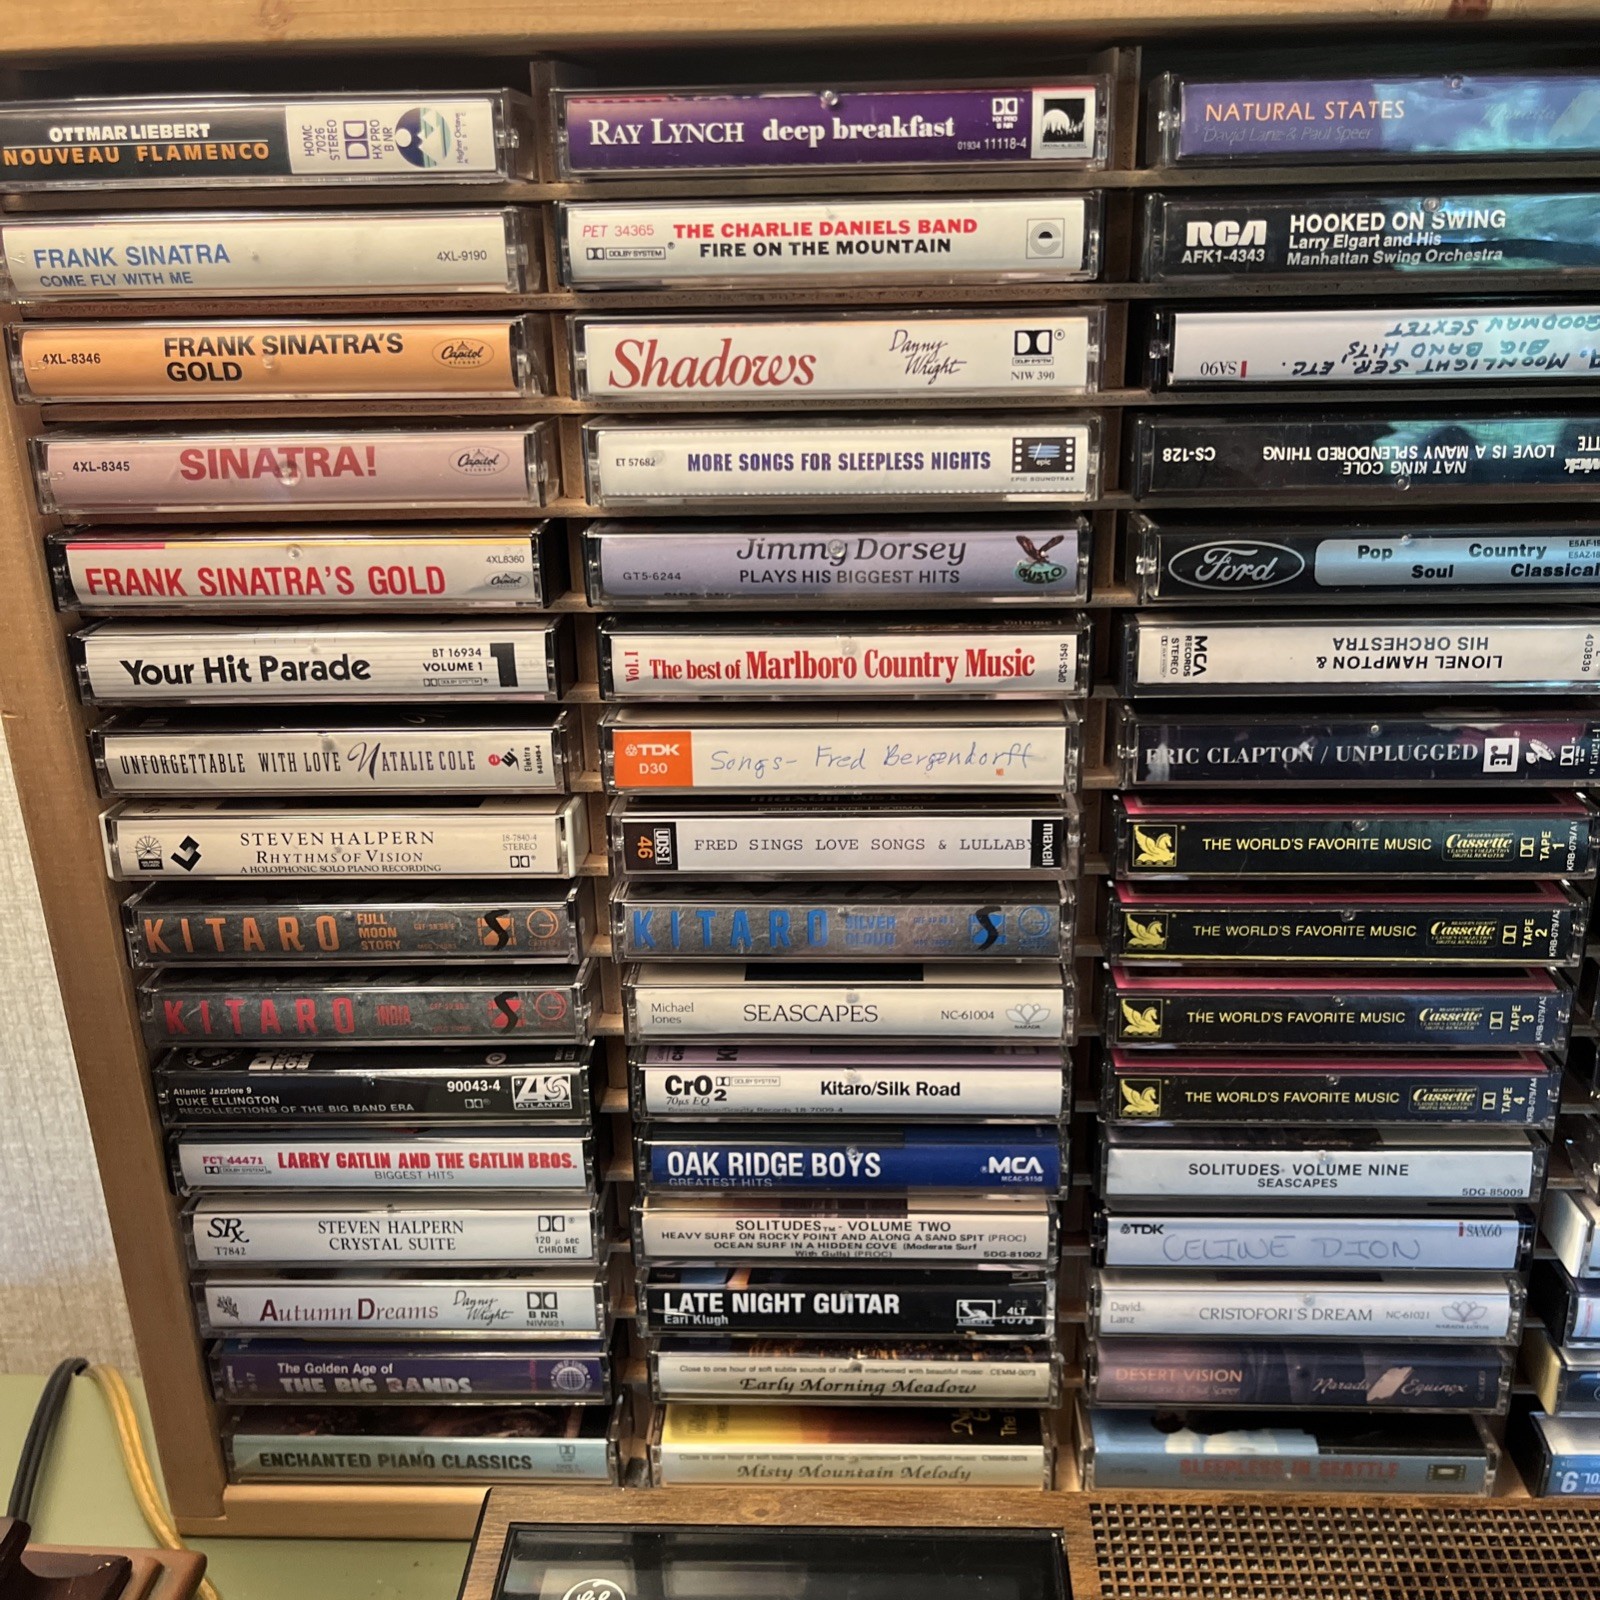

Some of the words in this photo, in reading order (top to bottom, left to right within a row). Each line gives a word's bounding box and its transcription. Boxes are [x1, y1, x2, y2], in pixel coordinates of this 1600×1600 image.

[1205, 102, 1315, 121] NATURAL
[1325, 101, 1405, 120] STATES
[49, 125, 127, 142] OTTMAR
[129, 124, 210, 140] LIEBERT
[369, 120, 381, 142] PRO
[302, 125, 315, 156] HOMC
[316, 127, 327, 153] 7026
[327, 120, 340, 160] STEREO
[3, 144, 120, 166] NOUVEAU
[138, 142, 269, 162] FLAMENCO
[373, 143, 383, 160] HX
[673, 225, 715, 239] THE
[720, 223, 814, 238] CHARLIE
[819, 221, 911, 236] DANIELS
[918, 219, 978, 234] BAND
[1290, 214, 1385, 233] HOOKED
[1392, 212, 1424, 231] ON
[1431, 210, 1506, 230] SWING
[583, 225, 608, 238] PET
[613, 224, 655, 237] 34365
[1186, 220, 1267, 247] RCA
[33, 249, 117, 269] FRANK
[126, 244, 231, 266] SINATRA
[436, 250, 488, 261] 4XL-9190
[1181, 250, 1265, 263] AFK1-4343
[39, 274, 88, 288] COME
[90, 273, 117, 286] FLY
[122, 272, 164, 285] WITH
[168, 271, 193, 284] ME
[1383, 319, 1477, 337] SEXTET
[163, 336, 255, 357] FRANK
[261, 333, 403, 356] SINATRA'S
[42, 353, 101, 365] 4XL-8346
[609, 338, 816, 389] Shadows
[166, 361, 242, 383] GOLD
[1010, 372, 1032, 380] NIW
[1036, 371, 1055, 380] 390
[1200, 362, 1236, 376] SA90
[687, 454, 733, 473] MORE
[739, 454, 794, 472] SONGS
[801, 454, 831, 471] FOR
[839, 452, 924, 471] SLEEPLESS
[930, 451, 991, 471] NIGHTS
[1163, 447, 1216, 462] CS-128
[72, 461, 130, 472] 4XL-8345
[179, 446, 376, 481] SINATRA!
[1343, 461, 1383, 475] COLE
[1390, 461, 1428, 475] KING
[1433, 461, 1467, 474] NAT
[486, 555, 525, 563] 4XL8360
[737, 538, 848, 566] Jimmy
[853, 538, 966, 564] Dorsey
[1358, 545, 1393, 560] Pop
[1469, 543, 1547, 560] Country
[1195, 548, 1276, 582] Ford
[85, 568, 183, 597] FRANK
[199, 567, 355, 597] SINATRA'S
[368, 566, 446, 595] GOLD
[740, 570, 797, 583] PLAYS
[802, 569, 832, 583] HIS
[836, 569, 914, 583] BIGGEST
[918, 570, 960, 582] HITS
[431, 648, 446, 658] BT
[448, 647, 482, 658] 16934
[1170, 638, 1179, 675] STEREO
[1193, 635, 1207, 676] MCA
[120, 659, 195, 685] Your
[203, 655, 252, 683] Hit
[260, 654, 371, 681] Parade
[422, 661, 474, 672] VOLUME
[477, 661, 483, 671] 1
[649, 658, 683, 680] The
[687, 659, 722, 679] best
[725, 659, 741, 679] of
[746, 650, 857, 680] Marlboro
[864, 649, 960, 683] Country
[965, 648, 1035, 678] Music
[1317, 656, 1326, 668] &
[1332, 656, 1430, 669] HAMPTON
[1436, 655, 1502, 668] LIONEL
[637, 744, 680, 756] TDK
[121, 754, 247, 775] UNFORGETTABLE
[258, 752, 299, 773] WITH
[304, 751, 341, 772] LOVE
[524, 747, 532, 772] Elektra
[639, 763, 668, 775] D30
[240, 832, 329, 847] STEVEN
[331, 831, 435, 845] HALPERN
[1042, 823, 1054, 866] maxell
[1202, 839, 1231, 851] THE
[1236, 838, 1303, 851] WORLD'S
[1308, 838, 1379, 850] FAVORITE
[1384, 838, 1432, 850] MUSIC
[1540, 830, 1552, 861] TAPE
[638, 836, 654, 859] 46
[356, 914, 388, 926] FULL
[144, 915, 343, 954] KITARO
[359, 927, 397, 939] MOON
[632, 909, 829, 949] KITARO
[1522, 918, 1534, 947] TAPE
[1535, 928, 1548, 937] 2
[361, 941, 401, 951] STORY
[651, 1002, 694, 1013] Michael
[743, 1004, 879, 1023] SEASCAPES
[940, 1010, 994, 1021] NC-61004
[651, 1014, 682, 1025] Jones
[447, 1081, 500, 1092] 90043-4
[821, 1082, 910, 1097] Kitaro/Silk
[916, 1082, 960, 1096] Road
[176, 1097, 207, 1106] DUKE
[211, 1096, 279, 1105] ELLINGTON
[667, 1152, 720, 1177] OAK
[727, 1153, 803, 1177] RIDGE
[811, 1152, 881, 1176] BOYS
[1188, 1164, 1280, 1176] SOLITUDES
[1293, 1164, 1364, 1176] VOLUME
[1368, 1164, 1409, 1176] NINE
[374, 1170, 432, 1180] BIGGEST
[437, 1170, 454, 1179] HITS
[735, 1221, 822, 1231] SOLITUDES
[848, 1221, 912, 1231] VOLUME
[917, 1221, 951, 1231] TWO
[1130, 1225, 1164, 1235] TDK
[215, 1246, 246, 1256] T7842
[329, 1238, 402, 1251] CRYSTAL
[408, 1238, 456, 1250] SUITE
[538, 1246, 577, 1254] CHROME
[260, 1299, 350, 1322] Autumn
[357, 1298, 439, 1320] Dreams
[664, 1293, 724, 1314] LATE
[732, 1293, 807, 1314] NIGHT
[814, 1293, 899, 1314] GUITAR
[1199, 1307, 1308, 1321] CRISTOFORI'S
[1312, 1308, 1373, 1321] DREAM
[278, 1363, 300, 1374] The
[305, 1363, 348, 1374] Golden
[352, 1363, 376, 1375] Age
[381, 1362, 393, 1374] of
[1116, 1368, 1177, 1382] DESERT
[1183, 1368, 1242, 1382] VISION
[740, 1378, 794, 1394] Early
[800, 1379, 887, 1396] Morning
[892, 1379, 976, 1394] Meadow
[259, 1453, 372, 1469] ENCHANTED
[378, 1455, 436, 1469] PIANO
[441, 1456, 532, 1470] CLASSICS
[737, 1465, 794, 1481] Misty
[799, 1466, 893, 1481] Mountain
[900, 1466, 971, 1482] Melody
